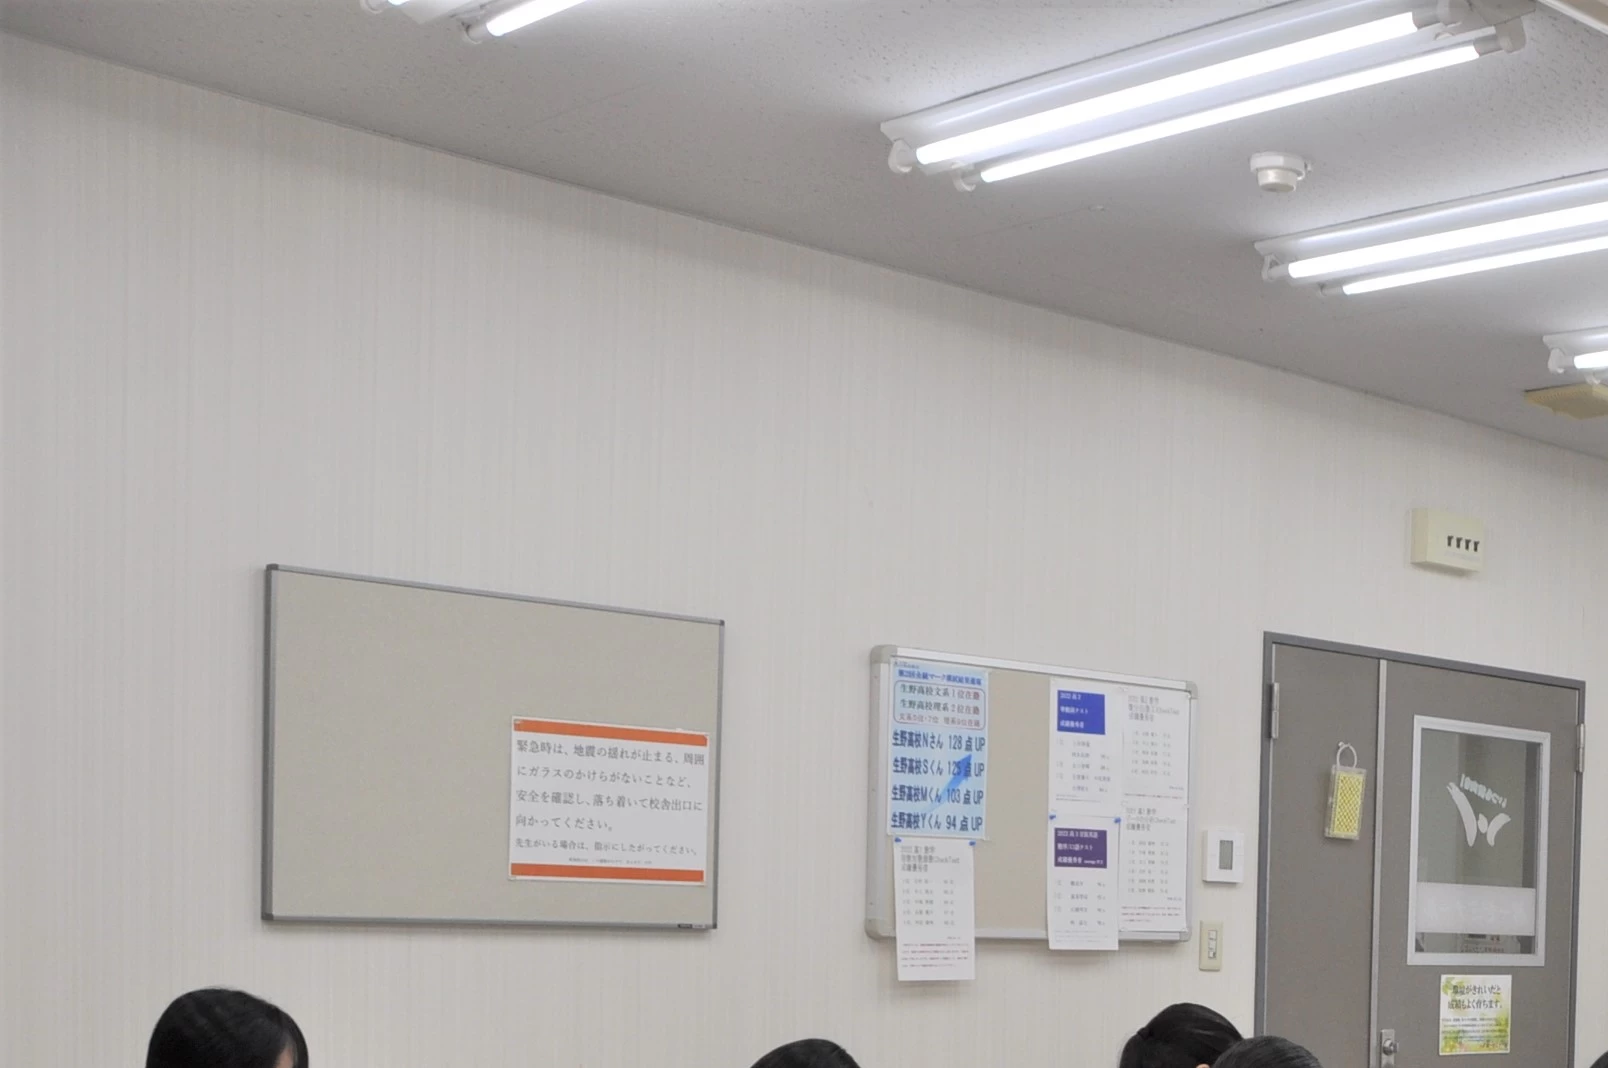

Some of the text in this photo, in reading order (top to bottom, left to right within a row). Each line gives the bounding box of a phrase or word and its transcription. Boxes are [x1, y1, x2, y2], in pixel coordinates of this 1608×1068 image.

[948, 733, 963, 750] 128
[975, 736, 986, 752] UP
[516, 738, 705, 766] 緊急時は、地震の揺れが止まる、周囲
[516, 765, 692, 789] にガラスのかけらがないことなど、
[974, 762, 984, 777] UP
[515, 789, 704, 812] 安全を確認し、落ち着いて校舎出口に
[973, 789, 984, 805] UP
[515, 814, 613, 832] 向かってください。
[945, 814, 957, 831] 94
[971, 816, 983, 832] UP
